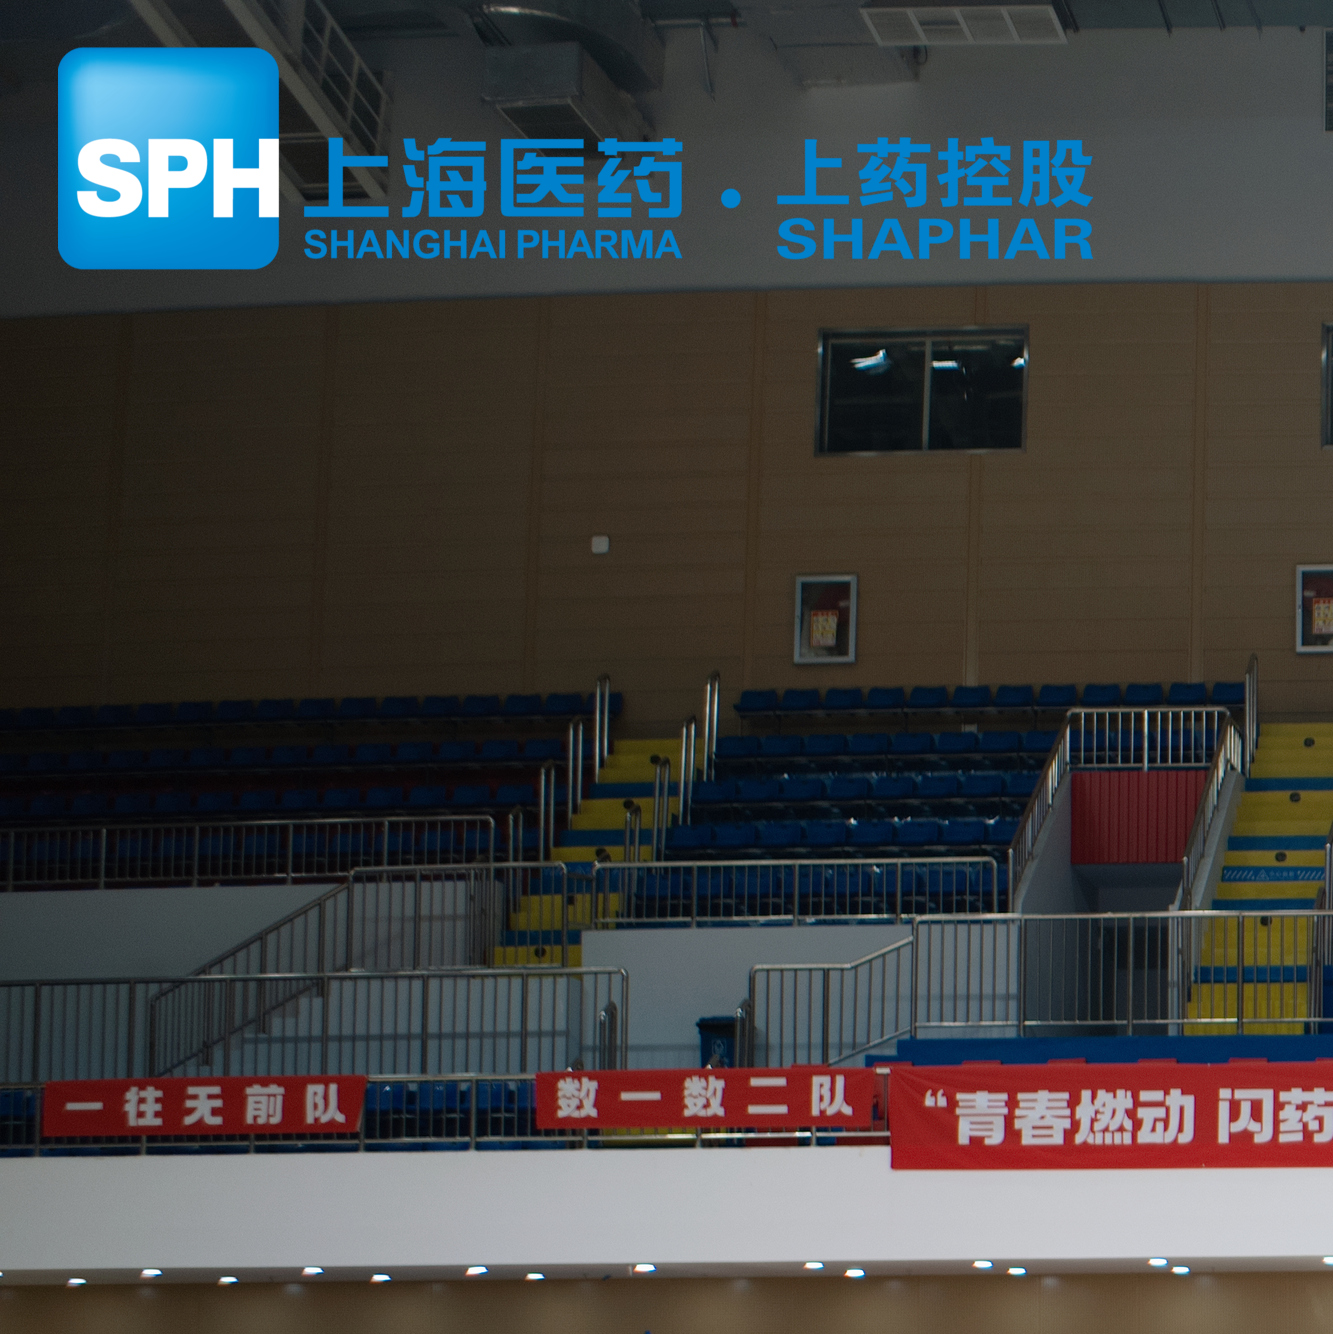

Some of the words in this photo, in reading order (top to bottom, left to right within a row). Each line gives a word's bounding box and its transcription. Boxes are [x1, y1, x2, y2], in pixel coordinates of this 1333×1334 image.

[64, 1083, 347, 1127] 一往无前队
[556, 1074, 854, 1119] 数一数二队
